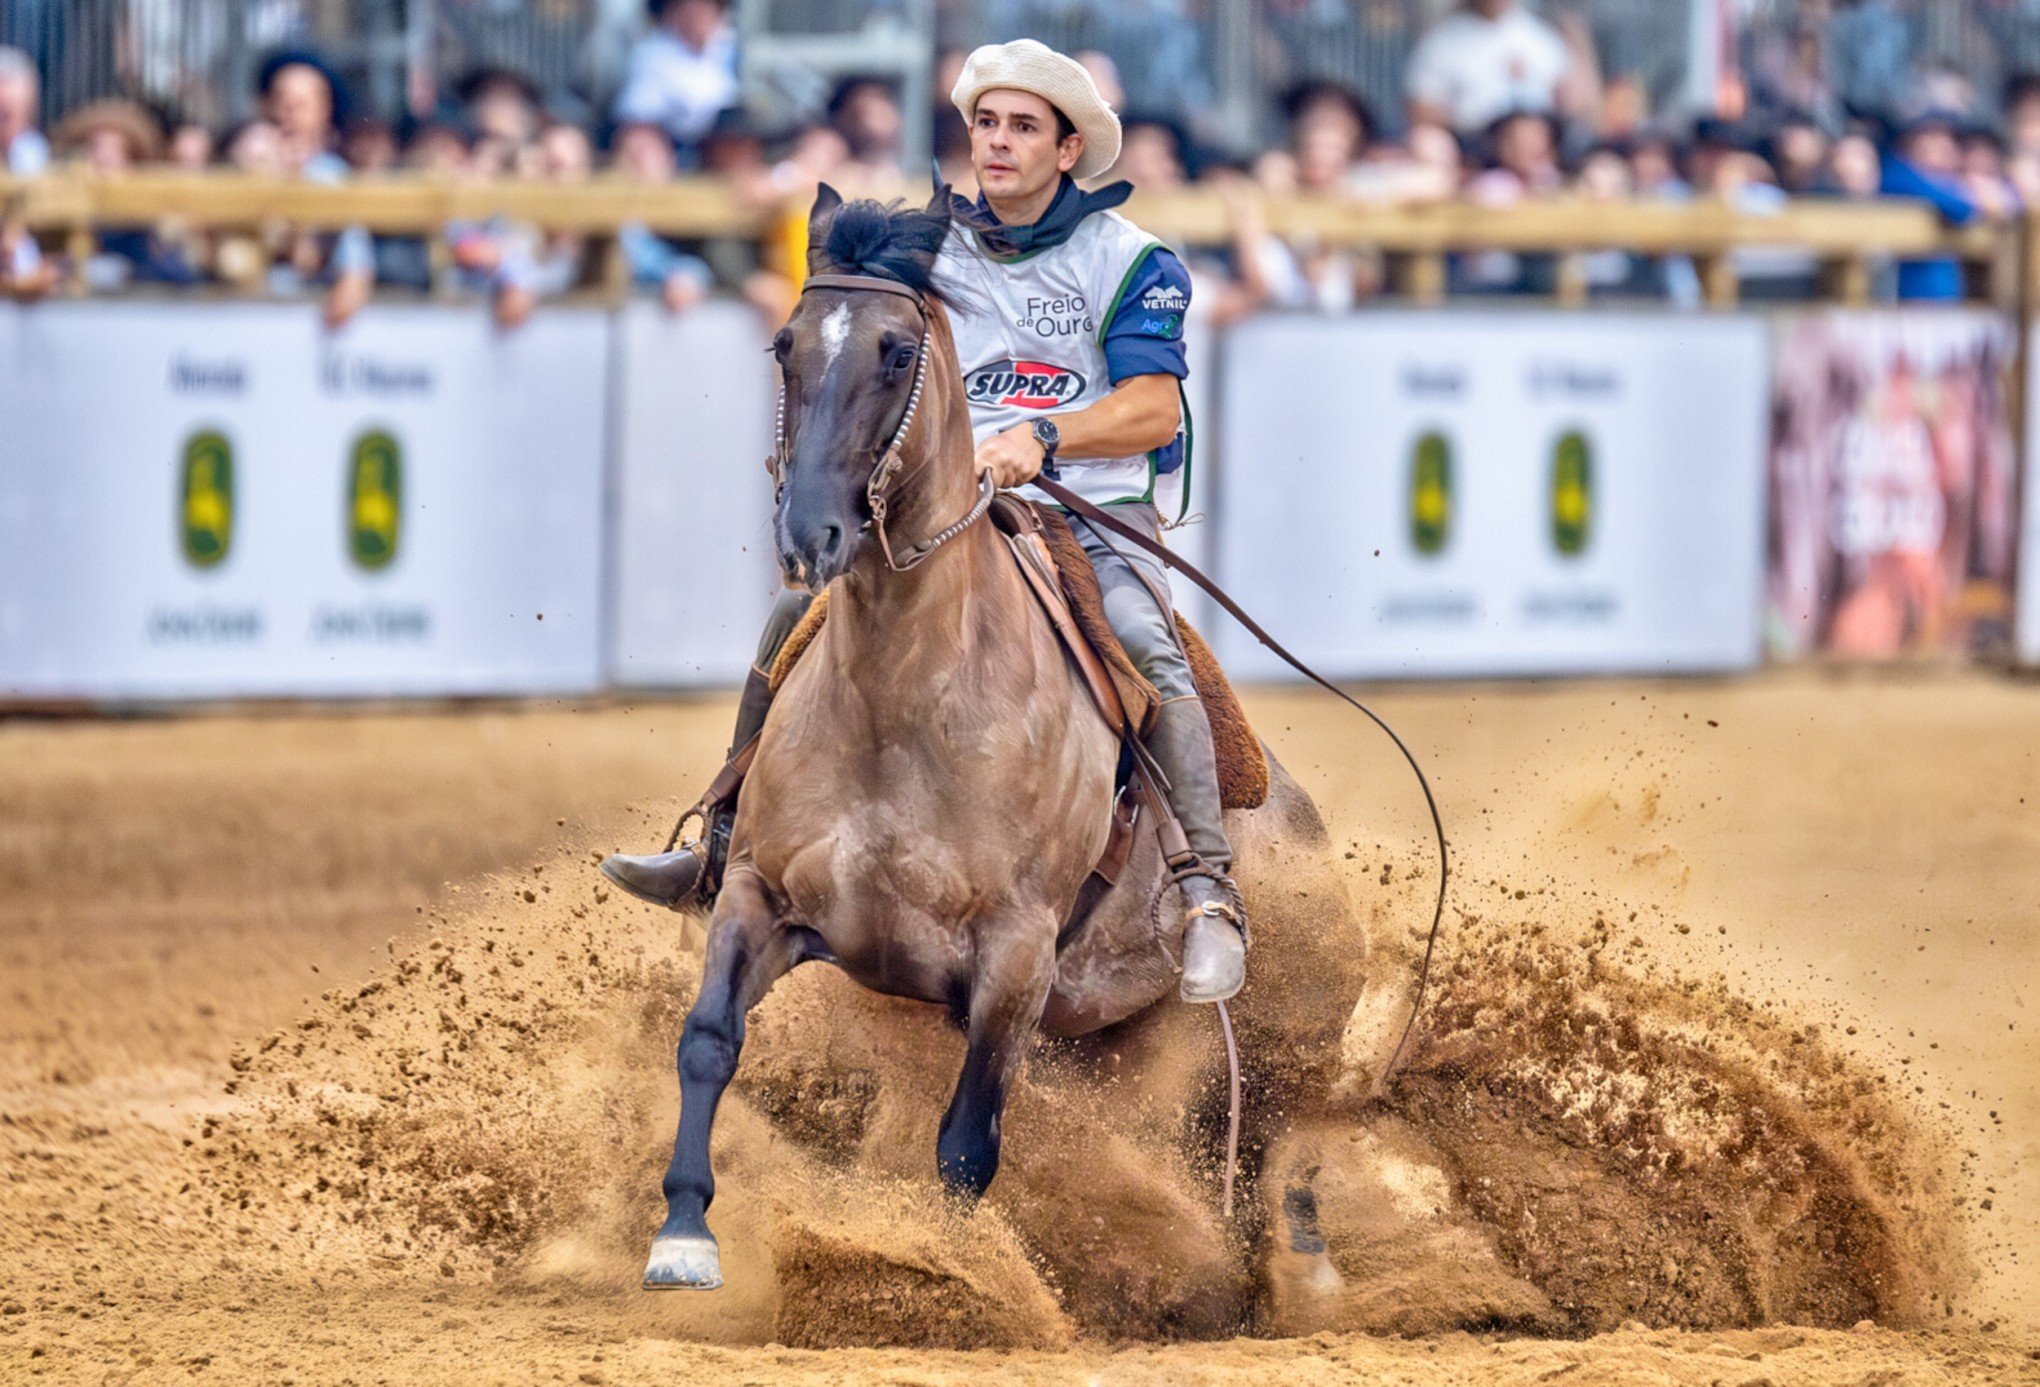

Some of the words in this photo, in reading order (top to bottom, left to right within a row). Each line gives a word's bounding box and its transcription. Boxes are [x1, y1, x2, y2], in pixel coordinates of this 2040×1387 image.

[1027, 294, 1086, 316] Freio
[1142, 299, 1187, 309] VETNIL
[1016, 317, 1034, 328] de
[970, 373, 1070, 396] SUPRA
